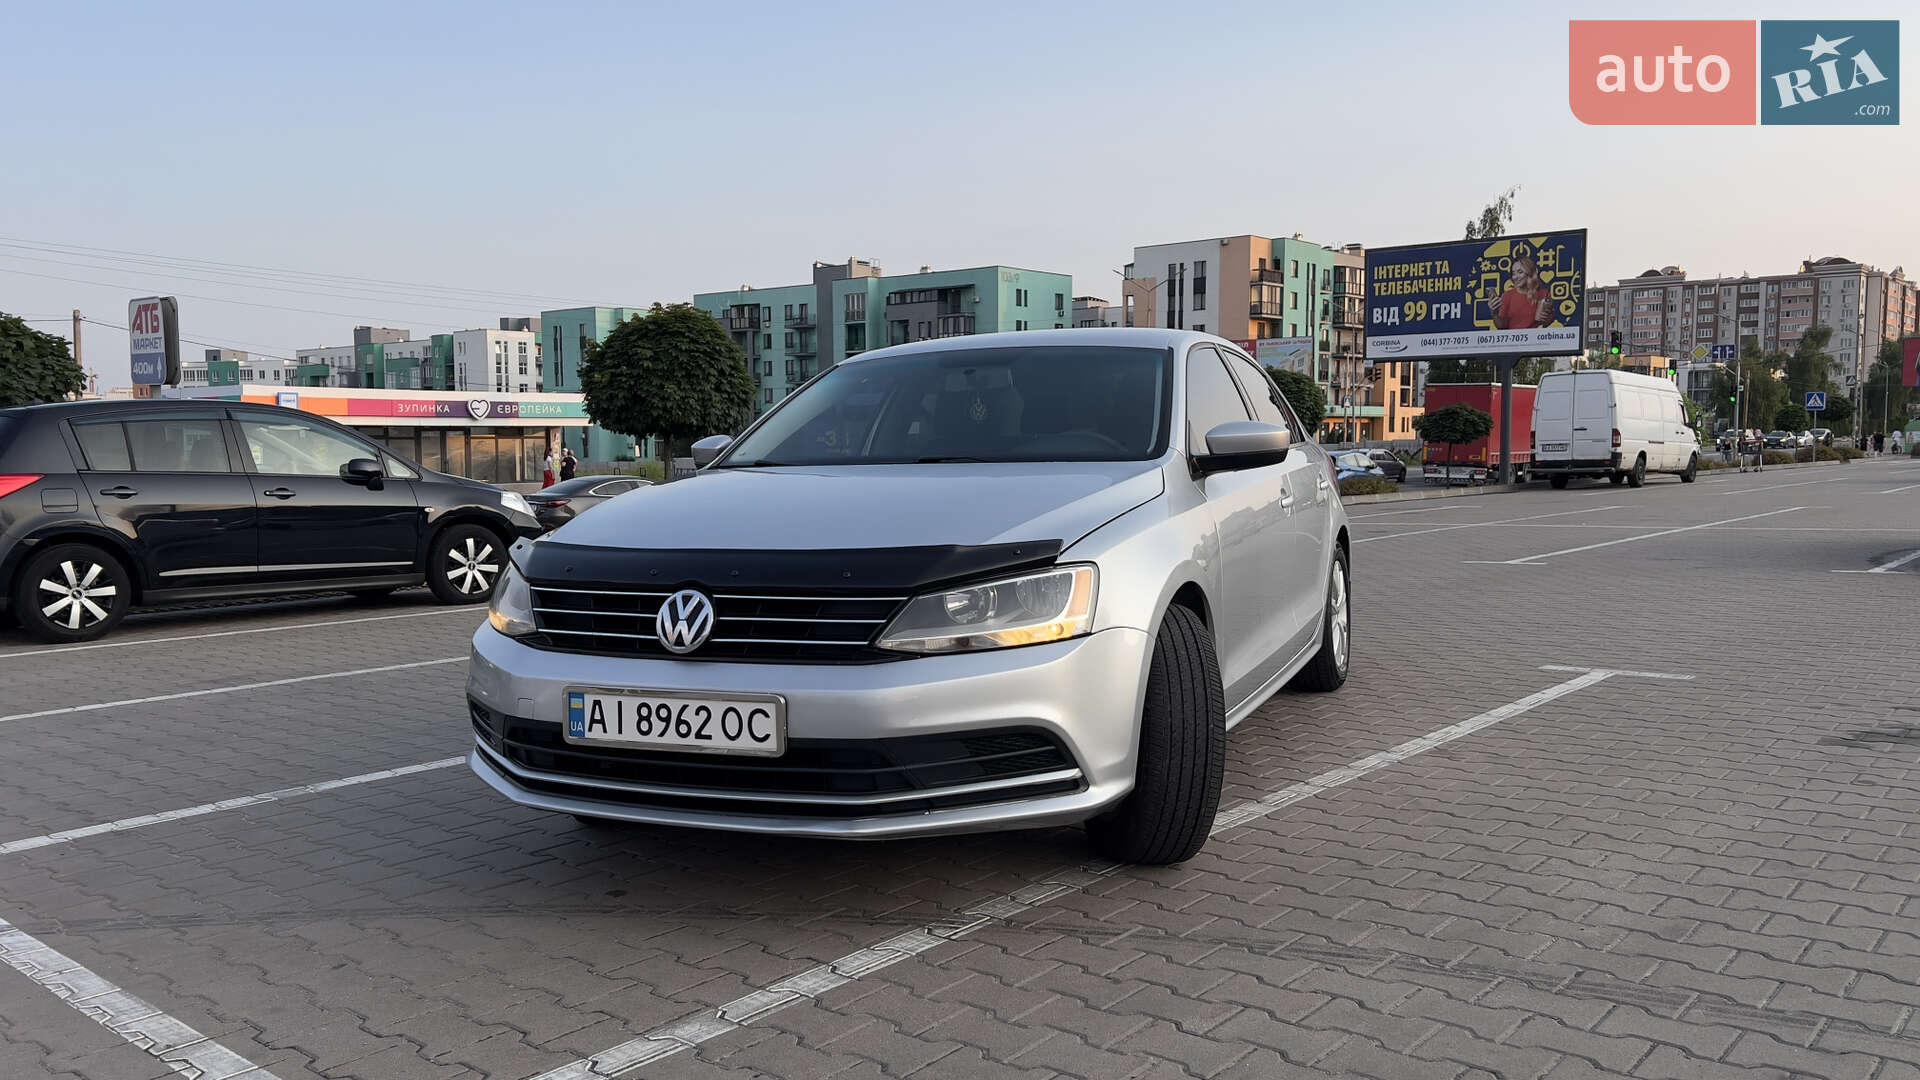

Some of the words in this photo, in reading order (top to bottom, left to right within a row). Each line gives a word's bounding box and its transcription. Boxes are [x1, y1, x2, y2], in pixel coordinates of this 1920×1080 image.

[1374, 261, 1433, 280] ІНТЕРНЕТ
[1435, 260, 1450, 275] ТА
[1373, 276, 1462, 297] ТЕЛЕБАЧЕННЯ
[1373, 306, 1400, 326] ВІД
[1403, 300, 1428, 322] 99
[1431, 302, 1462, 320] ГРН
[1537, 331, 1576, 341] corbina.ua
[397, 403, 450, 413] ЗУПИНКА
[497, 405, 562, 414] ЄВРОПЕЙКА
[570, 721, 584, 732] UA
